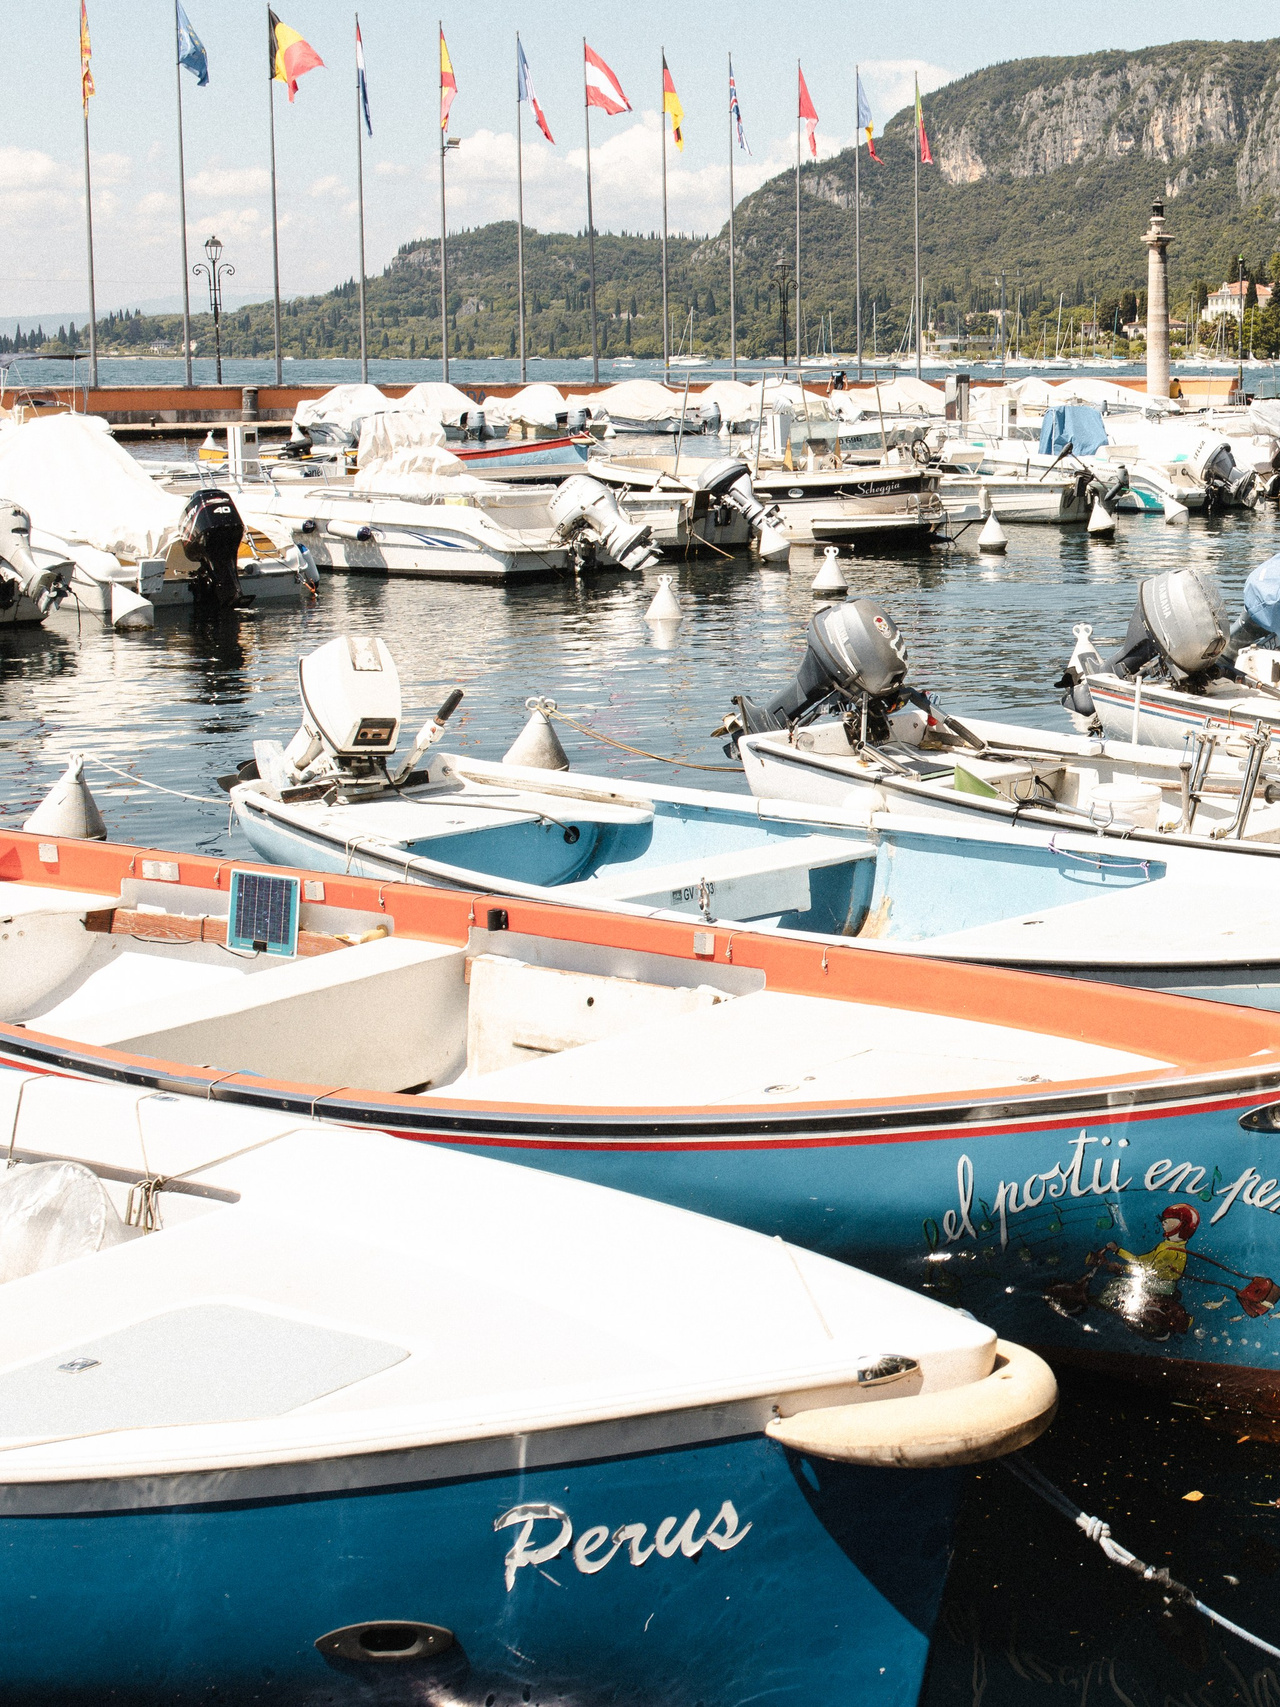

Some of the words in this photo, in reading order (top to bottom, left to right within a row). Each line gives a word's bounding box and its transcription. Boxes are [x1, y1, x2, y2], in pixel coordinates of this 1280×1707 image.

[550, 479, 577, 510] HONDA
[857, 481, 900, 495] Scheggia
[213, 506, 231, 514] 40
[1159, 581, 1172, 619] YAMAHA
[943, 1154, 978, 1244] el
[1144, 1158, 1208, 1195] en
[494, 1500, 753, 1593] Perus
